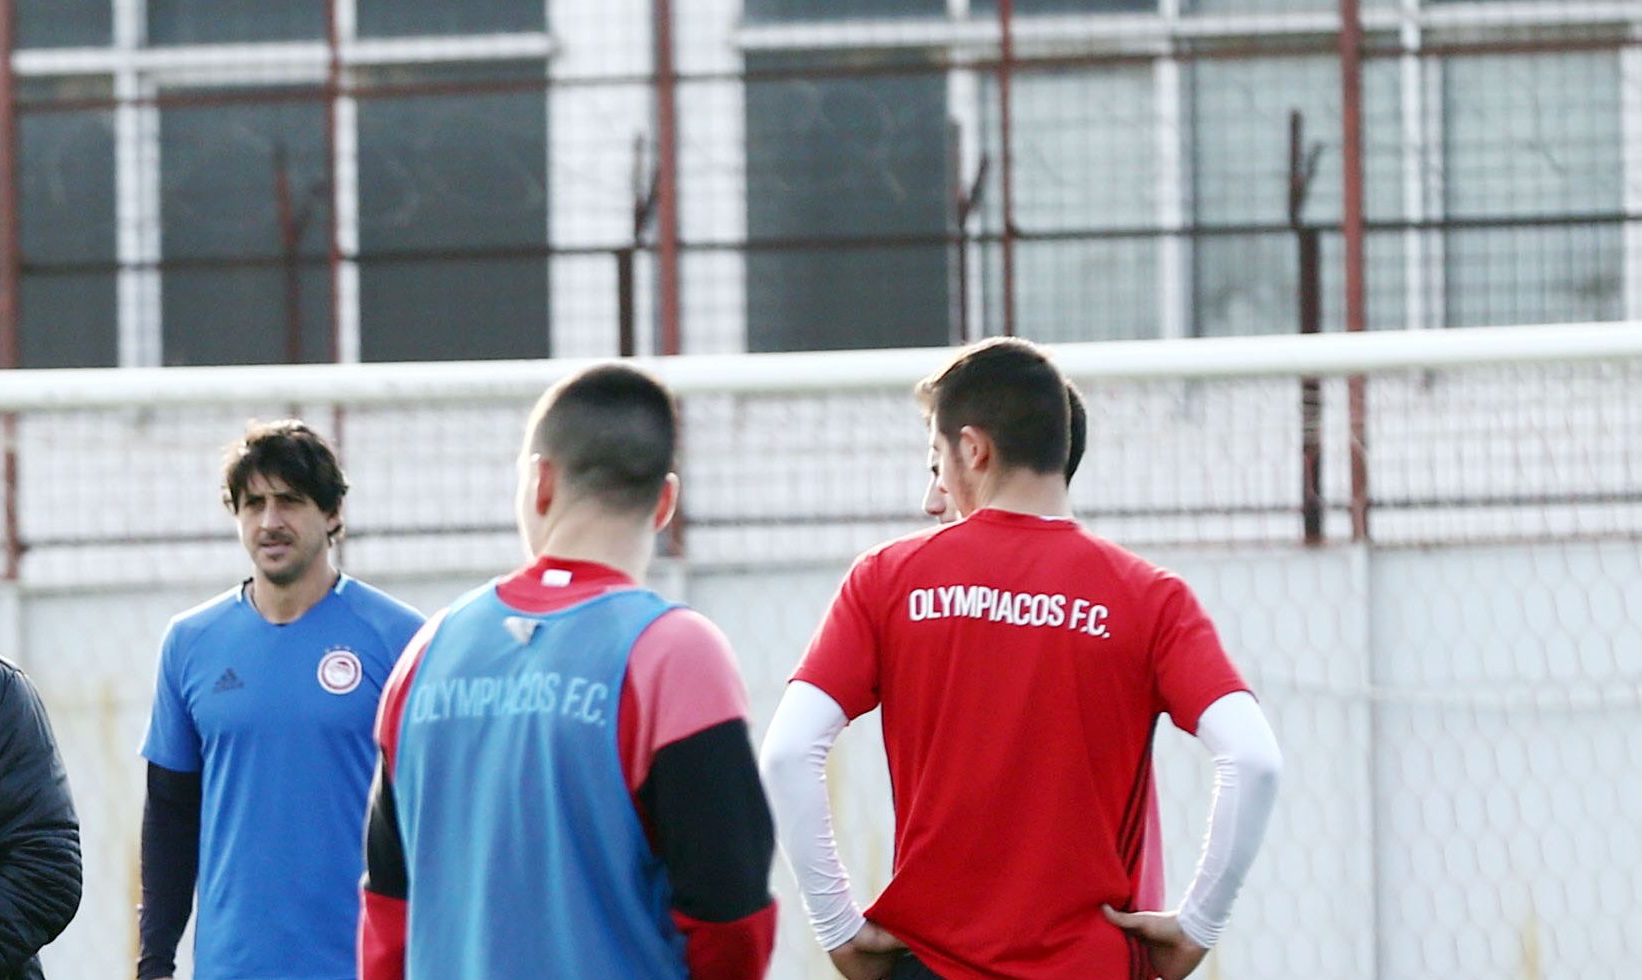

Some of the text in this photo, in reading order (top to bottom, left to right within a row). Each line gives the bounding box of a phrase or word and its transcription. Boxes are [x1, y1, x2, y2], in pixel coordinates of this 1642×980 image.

[909, 584, 1111, 639] OLYMPIACOS F.C.
[411, 671, 608, 726] OLYMPIACOS F.C.
